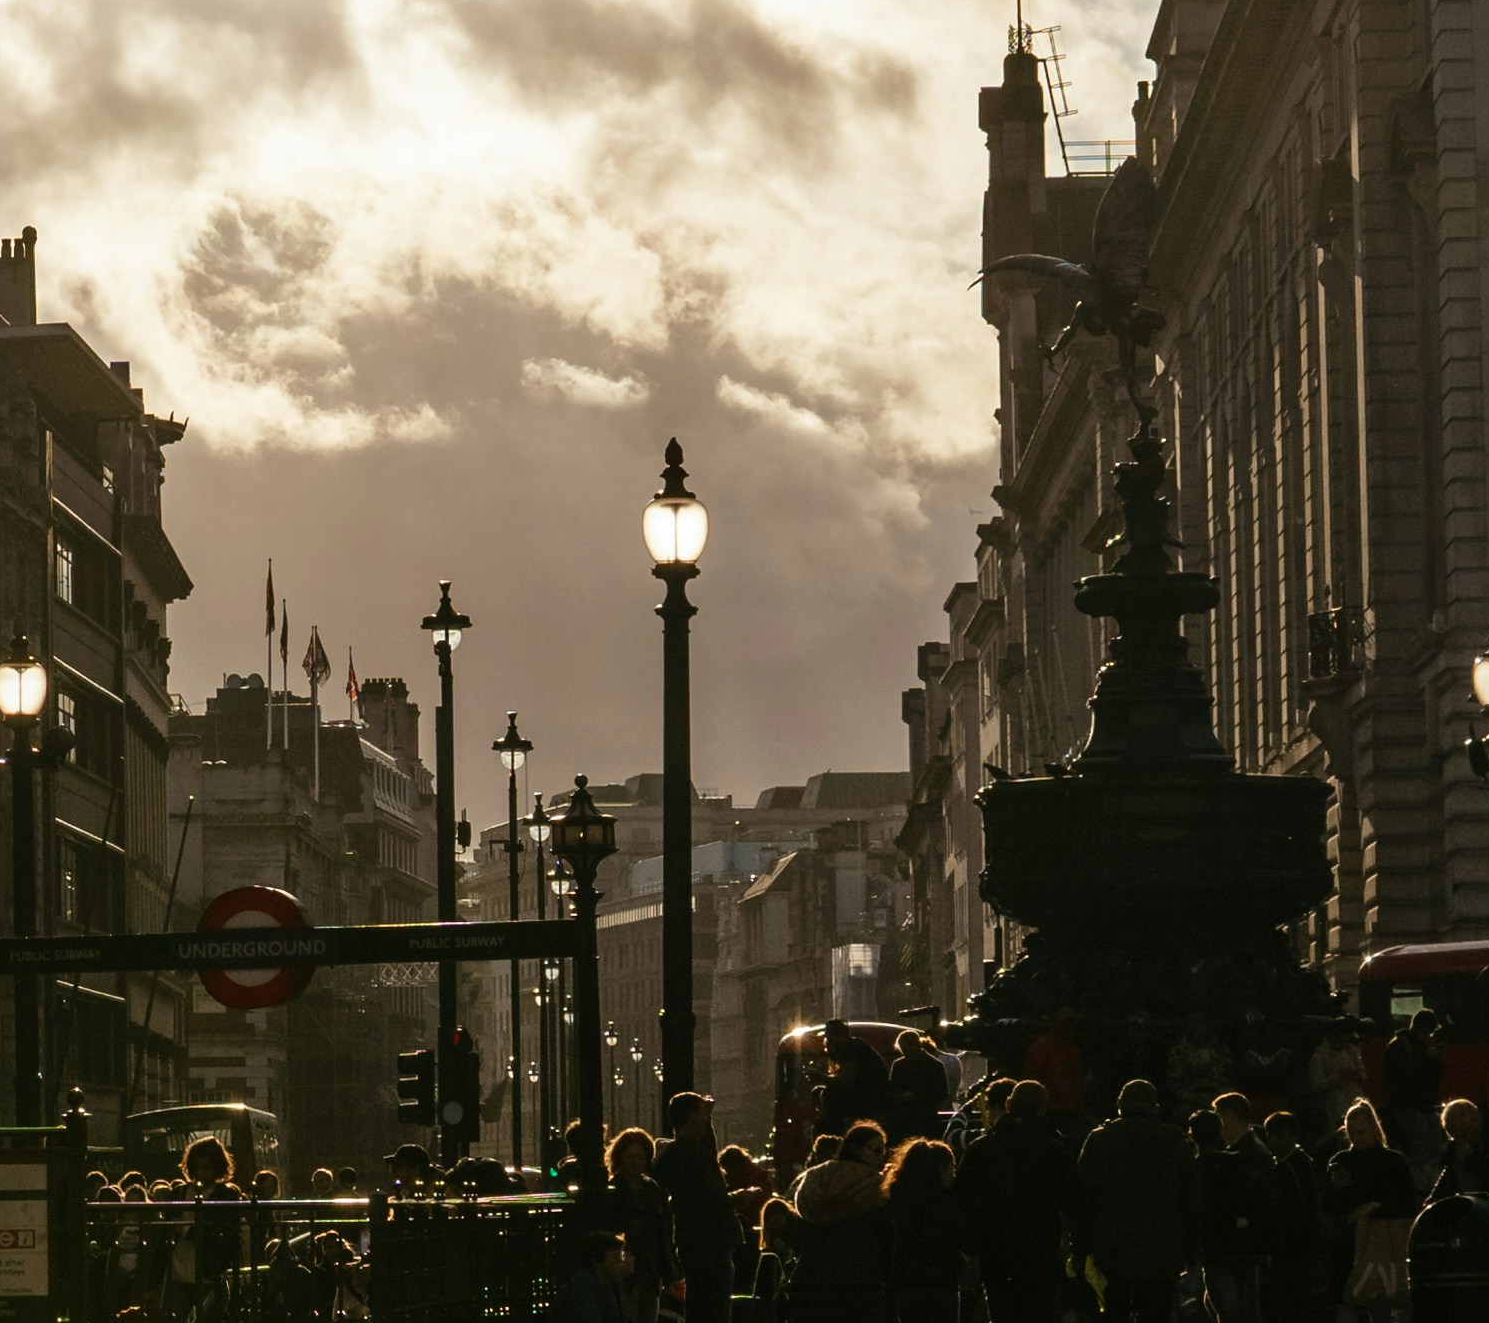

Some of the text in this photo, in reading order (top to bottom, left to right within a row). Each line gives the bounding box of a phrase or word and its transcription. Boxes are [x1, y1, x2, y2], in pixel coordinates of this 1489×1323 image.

[177, 939, 327, 959] UNDERGROUND
[409, 936, 505, 949] PUBLIC SUBWAY
[9, 949, 102, 962] PUBLIC SUBWAY
